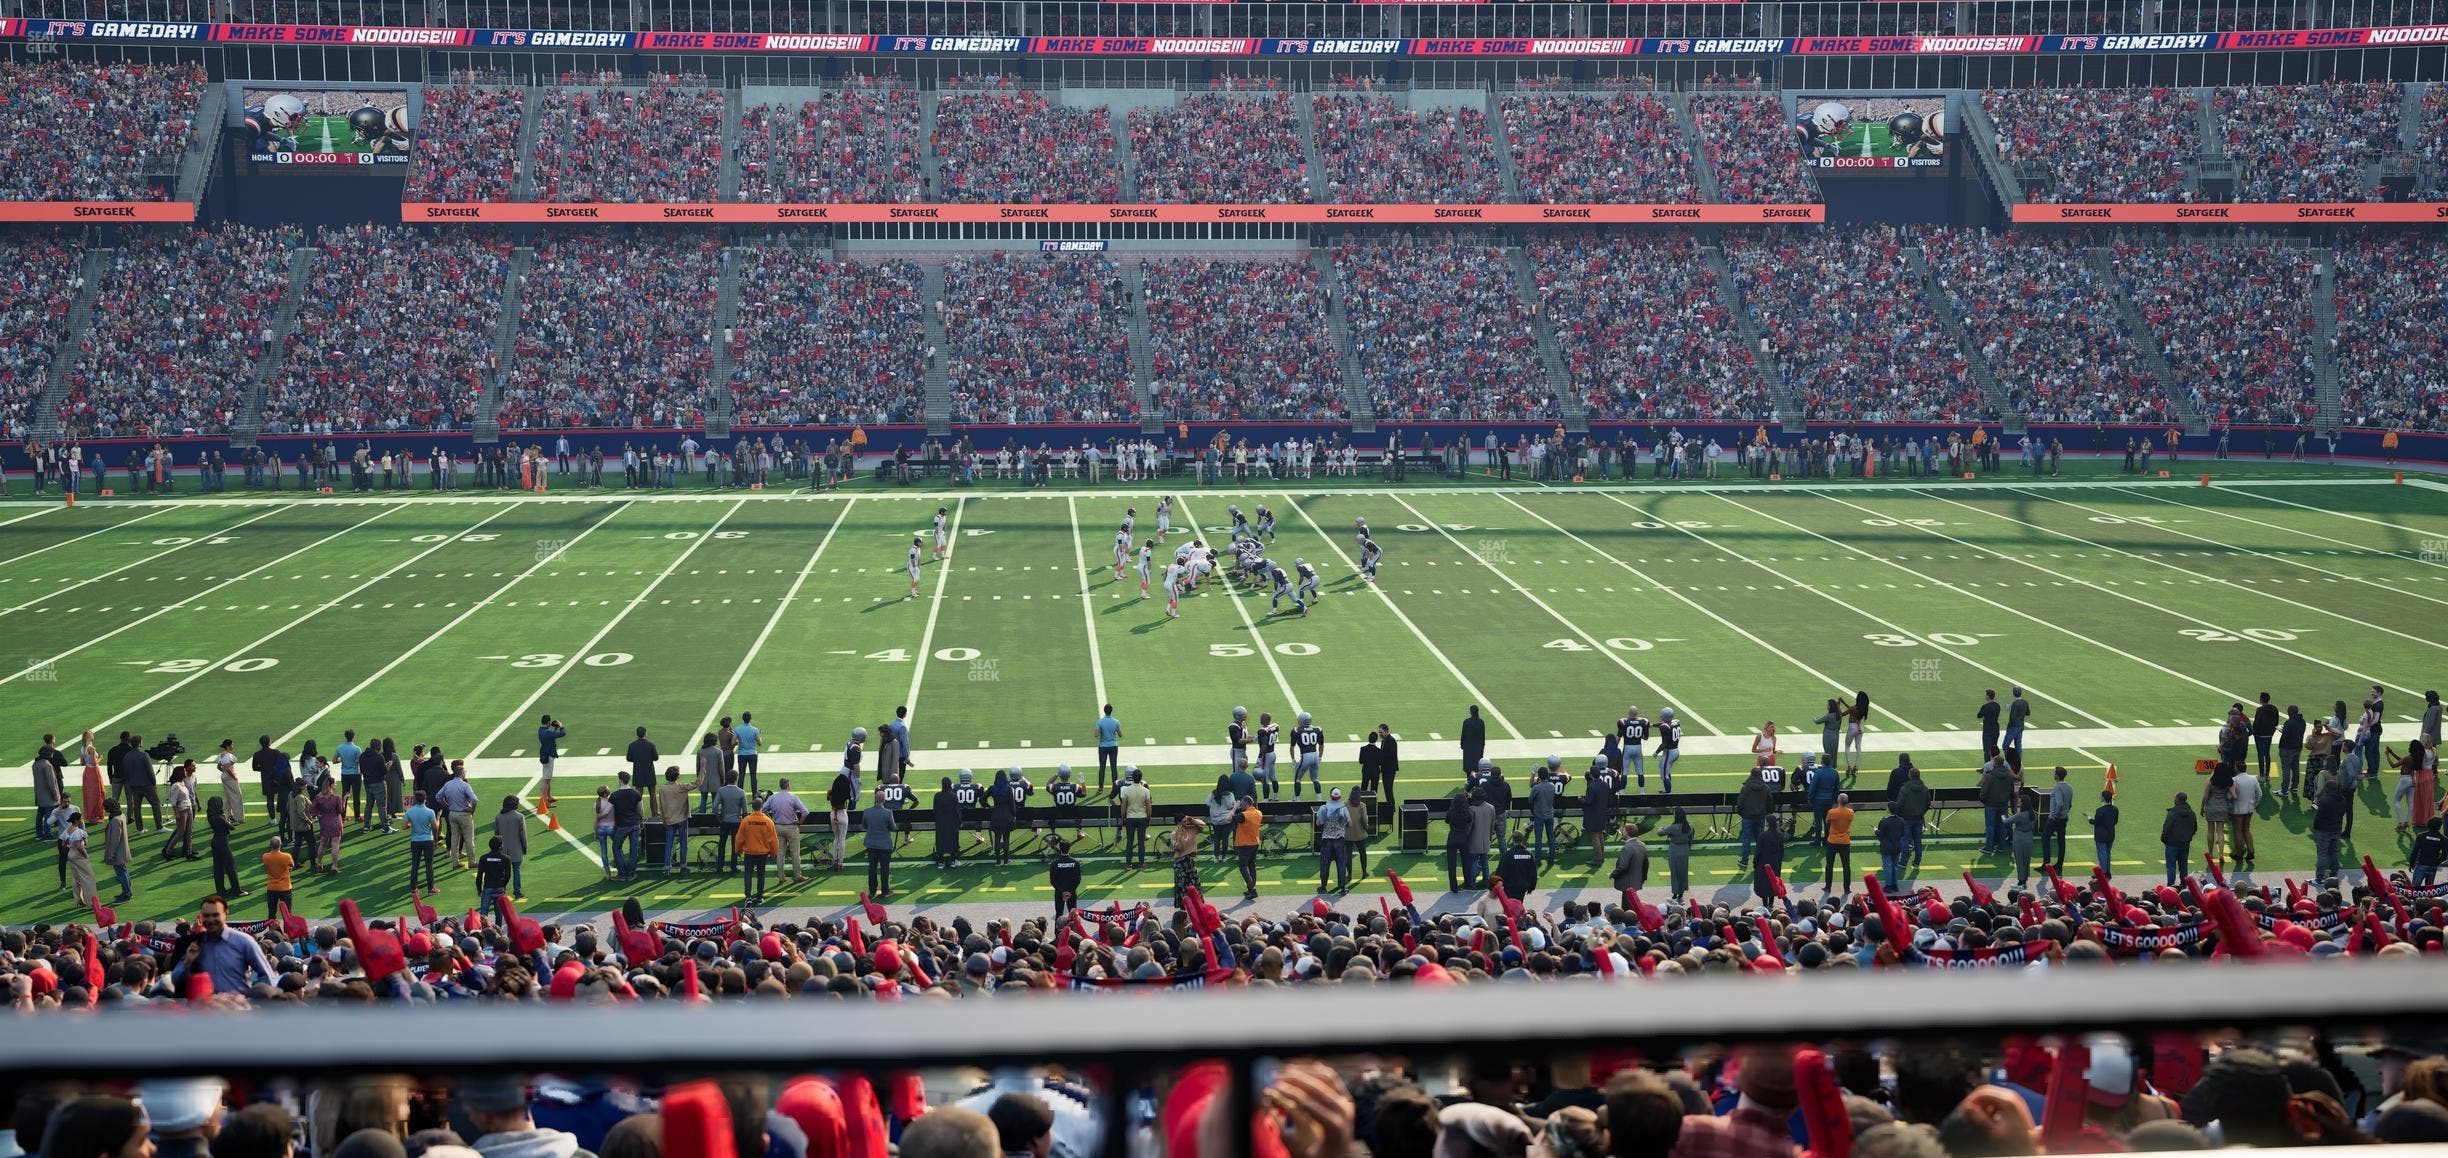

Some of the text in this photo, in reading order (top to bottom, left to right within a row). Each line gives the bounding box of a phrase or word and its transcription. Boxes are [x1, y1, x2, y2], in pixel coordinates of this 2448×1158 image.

[47, 22, 198, 38] IT'S GAMEDAY!
[227, 27, 457, 43] MAKE SOME NOOOOISE!!!
[491, 32, 626, 46] IT'S GAMEDAY!
[652, 34, 863, 49] MAKE SOME NOOOOISE!!!
[2060, 35, 2208, 50] IT'S GAMEDAY!
[2237, 33, 2298, 46] MAKE
[2305, 30, 2364, 44] SOME
[894, 37, 1020, 51] IT'S GAMEDAY!
[1044, 39, 1246, 53] MAKE SOME NOOOOISE!!!
[1276, 40, 1400, 53] IT'S GAMEDAY!
[1425, 40, 1627, 53] MAKE SOME NOOOOISE!!!
[1657, 40, 1784, 53] IT'S GAMEDAY!
[1809, 37, 2024, 52] MAKE SOME NOOOOISE!!!
[251, 154, 273, 162] HOME
[280, 153, 290, 163] 0
[295, 153, 337, 163] 00:00
[361, 153, 371, 163] 0
[376, 154, 408, 162] VISITORS
[1823, 158, 1832, 167] 0
[1836, 158, 1874, 167] 00:00
[1896, 158, 1906, 167] 0
[1910, 158, 1941, 166] VISITORS
[73, 207, 136, 217] SEATGEEK
[427, 208, 480, 217] SEATGEEK
[546, 208, 599, 217] SEATGEEK
[663, 208, 714, 217] SEATGEEK
[778, 208, 828, 217] SEATGEEK
[890, 208, 939, 217] SEATGEEK
[1000, 208, 1049, 217] SEATGEEK
[1110, 208, 1158, 217] SEATGEEK
[1218, 208, 1266, 217] SEATGEEK
[1326, 208, 1374, 217] SEATGEEK
[1434, 208, 1482, 217] SEATGEEK
[1543, 208, 1591, 217] SEATGEEK
[1652, 208, 1701, 217] SEATGEEK
[1762, 208, 1811, 217] SEATGEEK
[2061, 208, 2112, 217] SEATGEEK
[2176, 208, 2229, 217] SEATGEEK
[2297, 208, 2356, 217] SEATGEEK
[1042, 241, 1104, 251] IT'S GAMEDAY!
[1625, 726, 1642, 739] 00
[1301, 732, 1317, 745] 00
[2203, 761, 2214, 770] 30
[1761, 769, 1779, 782] 00
[884, 787, 903, 801] 00
[957, 789, 974, 803] 00
[1056, 791, 1074, 805] 00
[1083, 911, 1100, 922] LET'S
[664, 923, 684, 936] LET'S
[2103, 926, 2199, 949] LET'S GOOOOO!!!
[149, 939, 172, 952] LET'S
